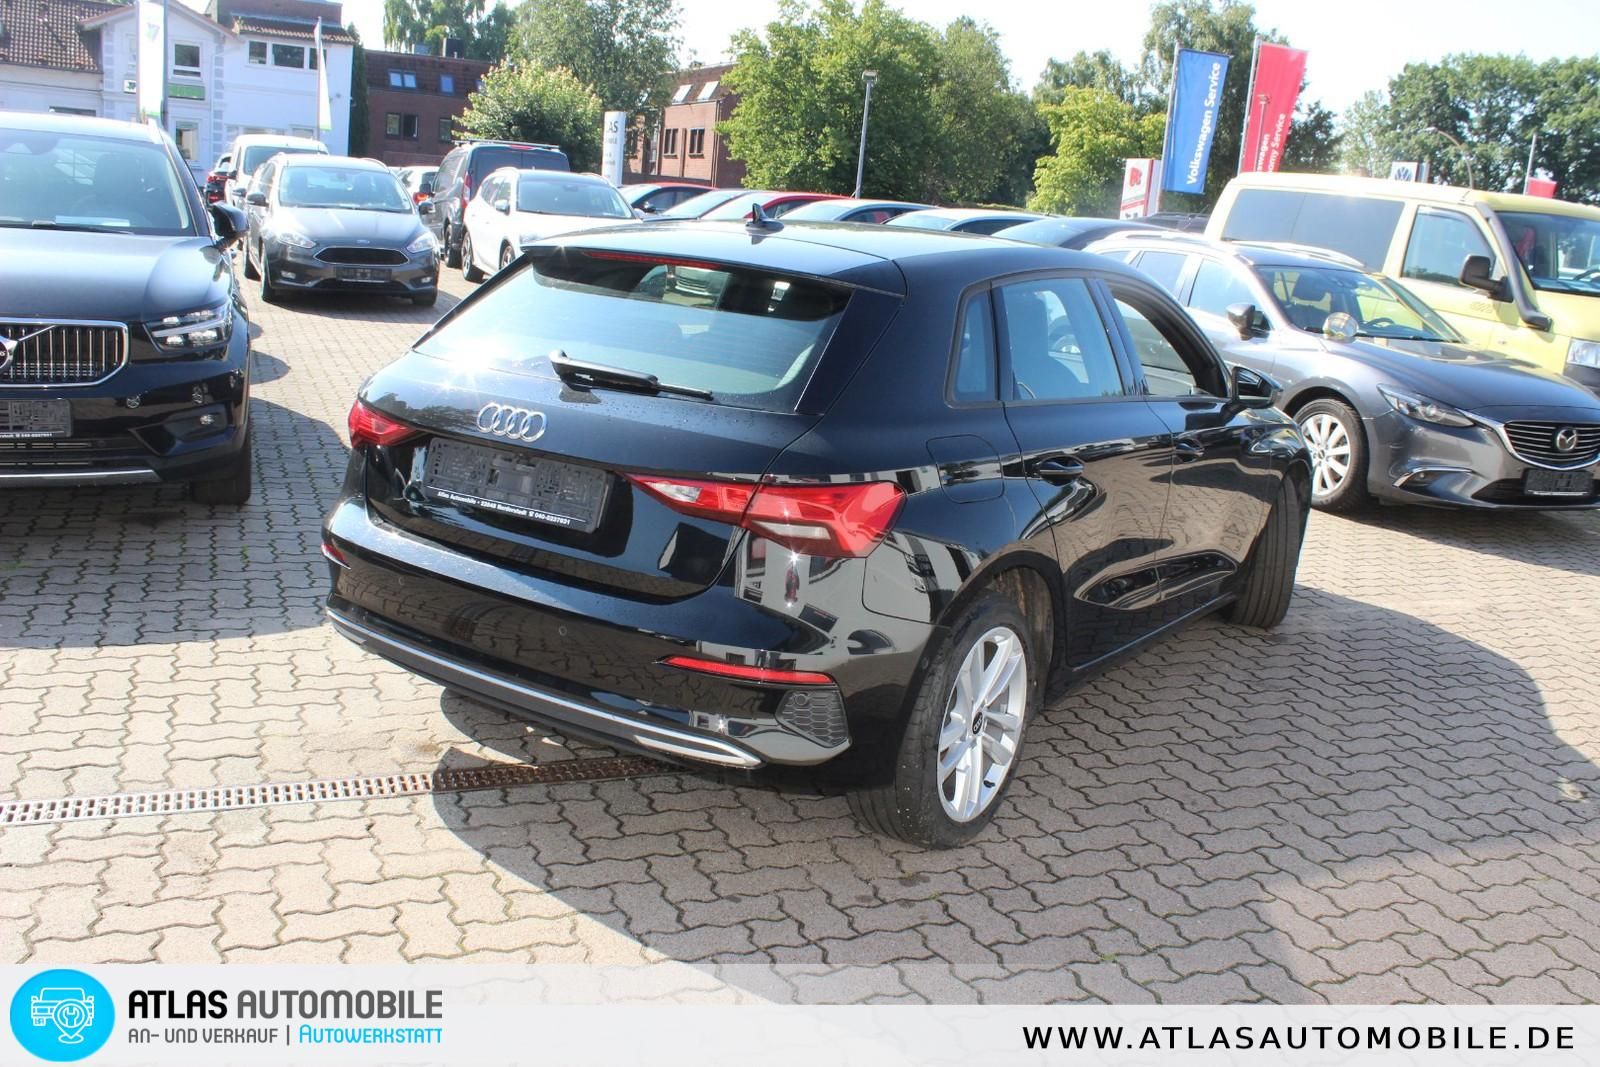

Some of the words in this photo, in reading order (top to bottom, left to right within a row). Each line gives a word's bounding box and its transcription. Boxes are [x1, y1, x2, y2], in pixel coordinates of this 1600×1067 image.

[1186, 110, 1213, 185] Volkswagen
[1204, 62, 1221, 108] Service
[1271, 113, 1286, 148] Service
[1257, 133, 1270, 172] swagen
